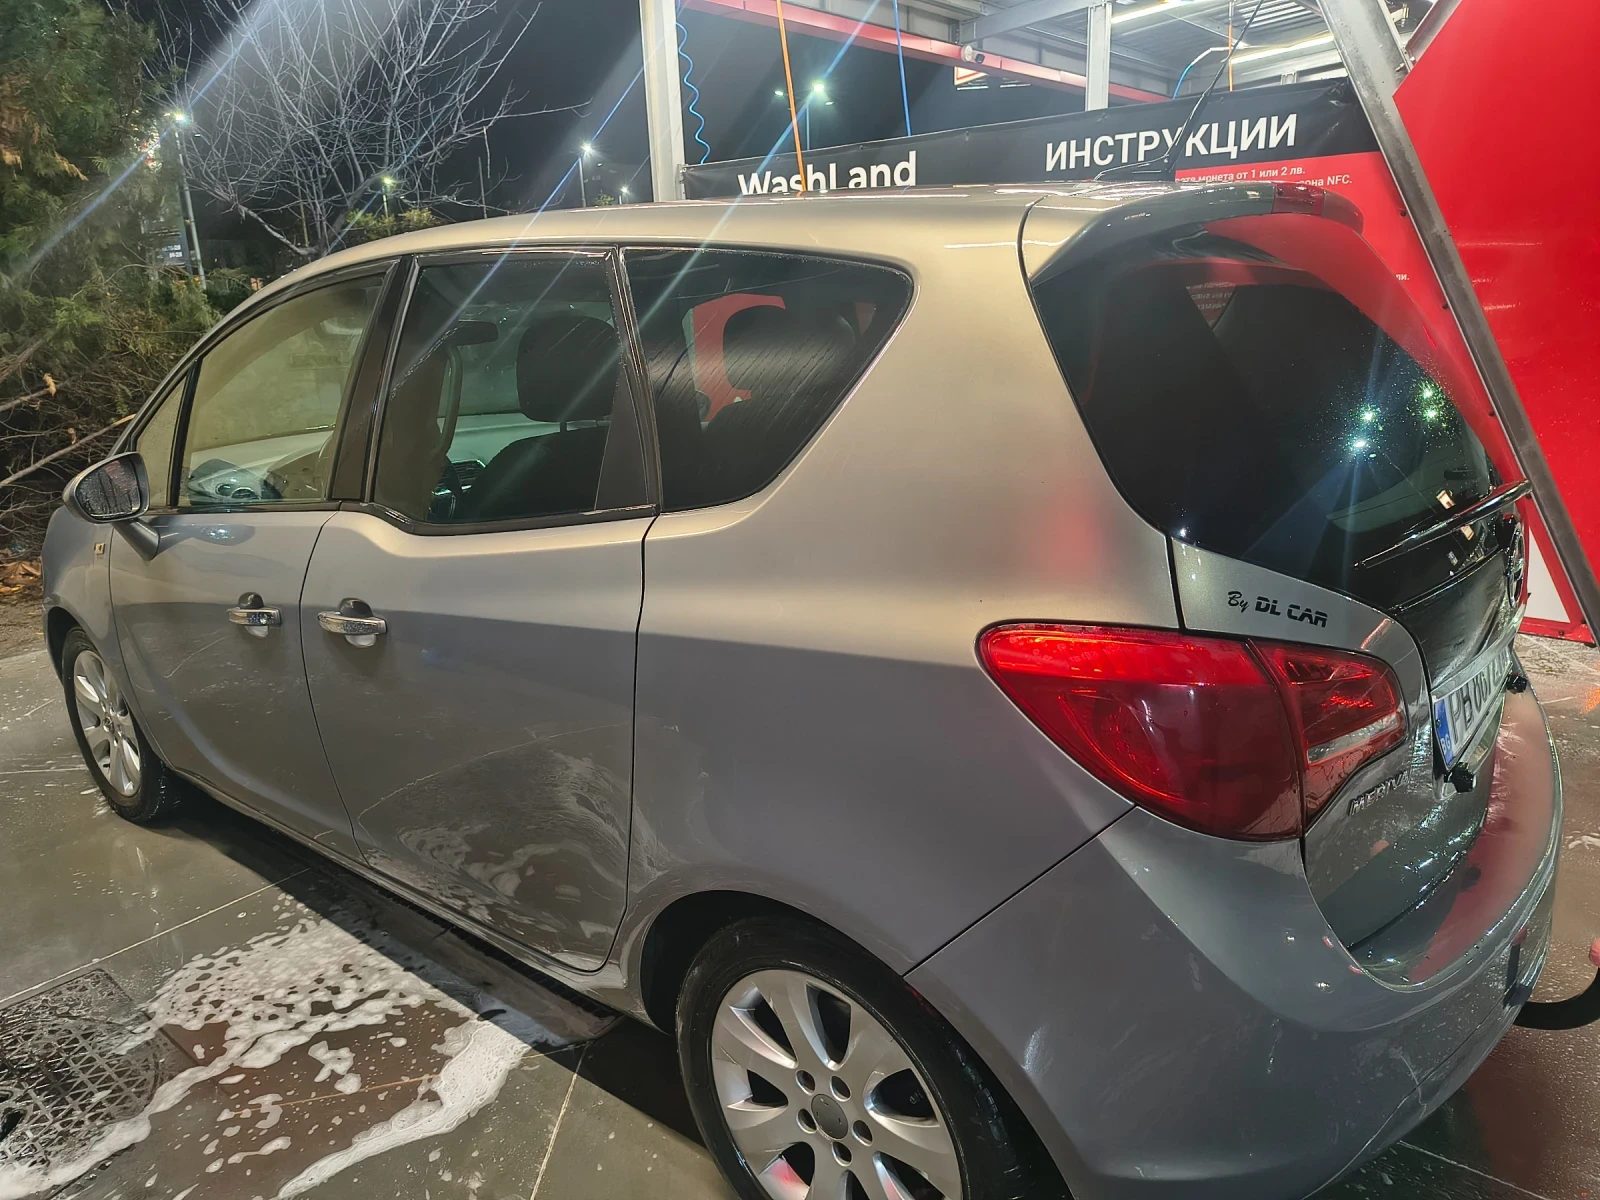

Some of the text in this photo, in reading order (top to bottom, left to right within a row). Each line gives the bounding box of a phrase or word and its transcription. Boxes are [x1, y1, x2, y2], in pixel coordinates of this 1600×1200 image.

[1045, 113, 1298, 172] ИНСТРУКЦИИ
[737, 150, 917, 196] WashLand
[1236, 171, 1249, 180] от
[1251, 169, 1256, 179] 1
[1259, 169, 1278, 178] или
[1281, 166, 1288, 176] 2
[1289, 166, 1306, 176] лв.
[1327, 174, 1353, 186] NFC.
[1227, 590, 1328, 628] By DL CAR
[1440, 733, 1452, 755] BG
